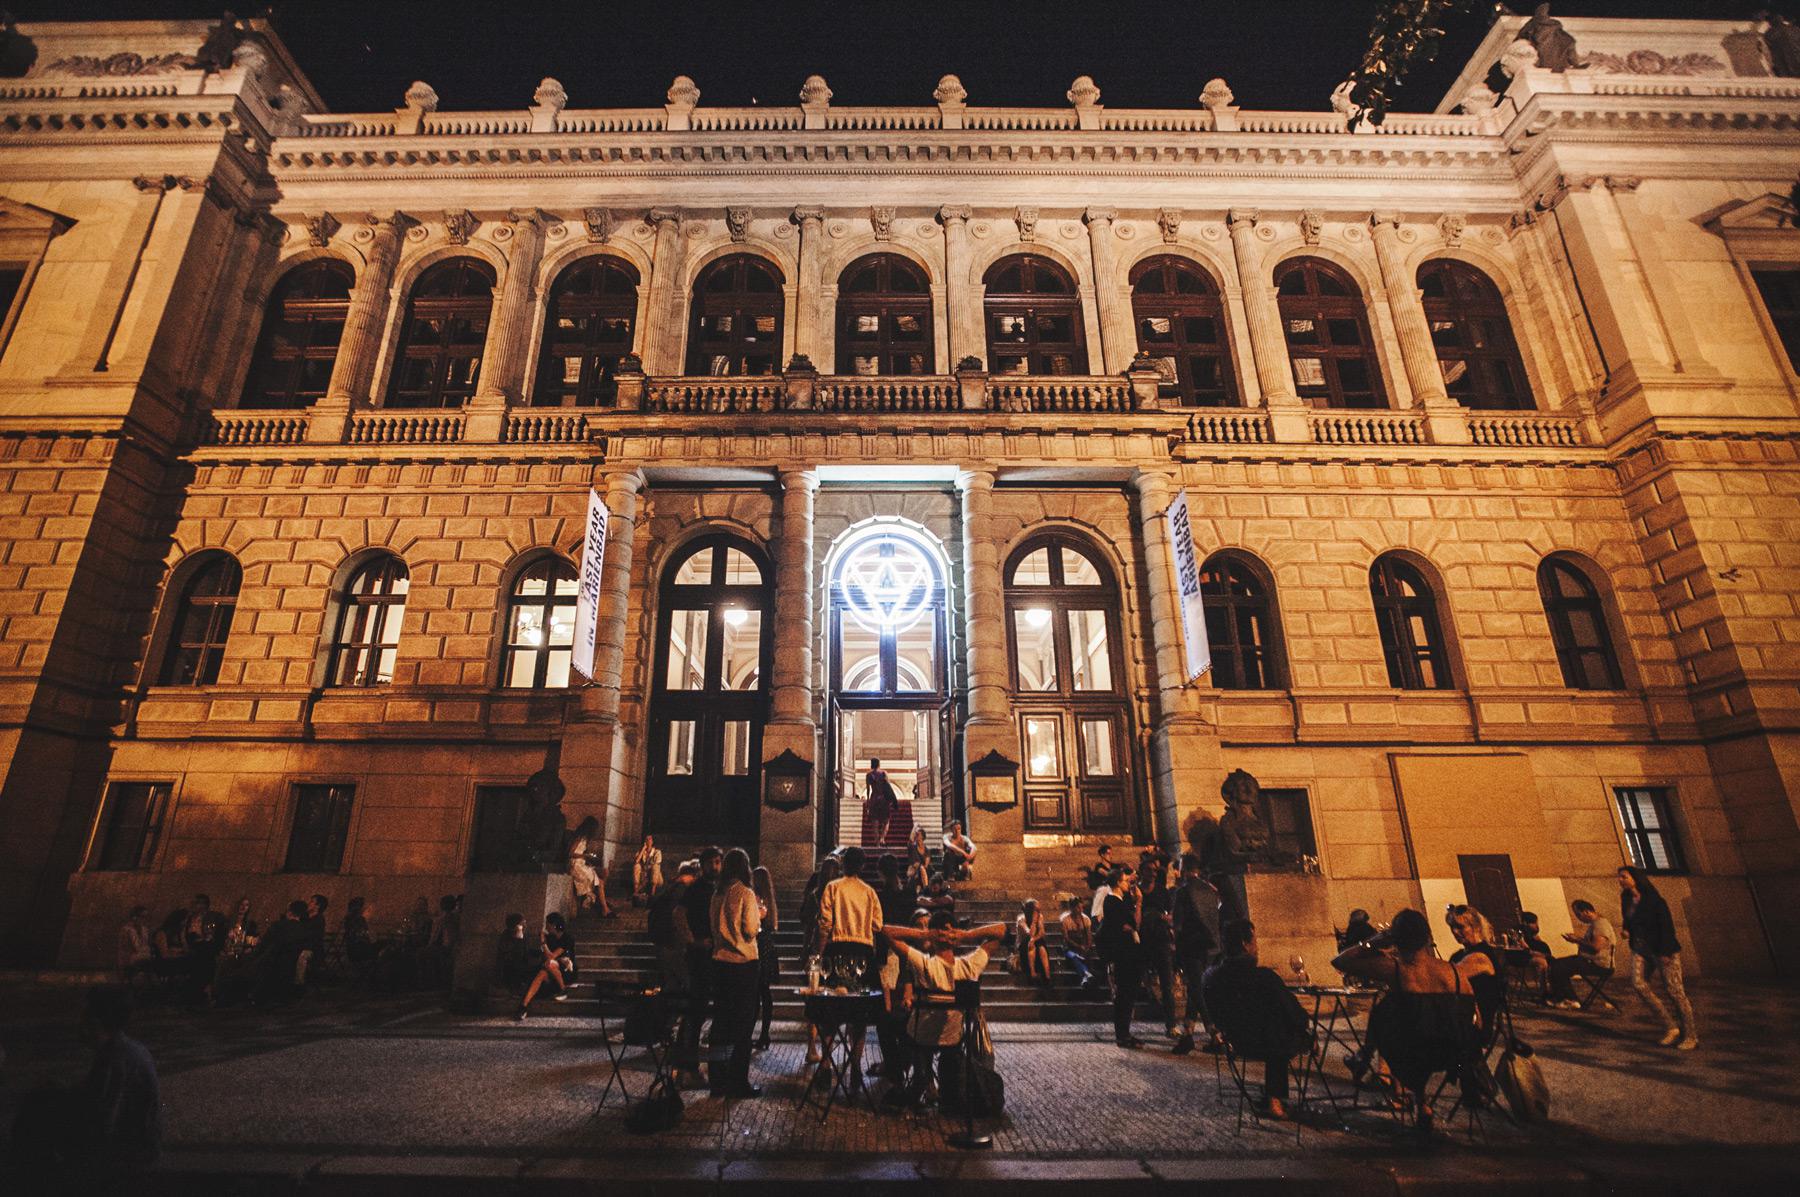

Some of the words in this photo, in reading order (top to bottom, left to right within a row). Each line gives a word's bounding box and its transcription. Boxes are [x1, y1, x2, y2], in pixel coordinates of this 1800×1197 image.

[589, 506, 600, 553] YEAR
[1174, 511, 1184, 561] YEAR
[1180, 503, 1198, 596] ARIENBAD
